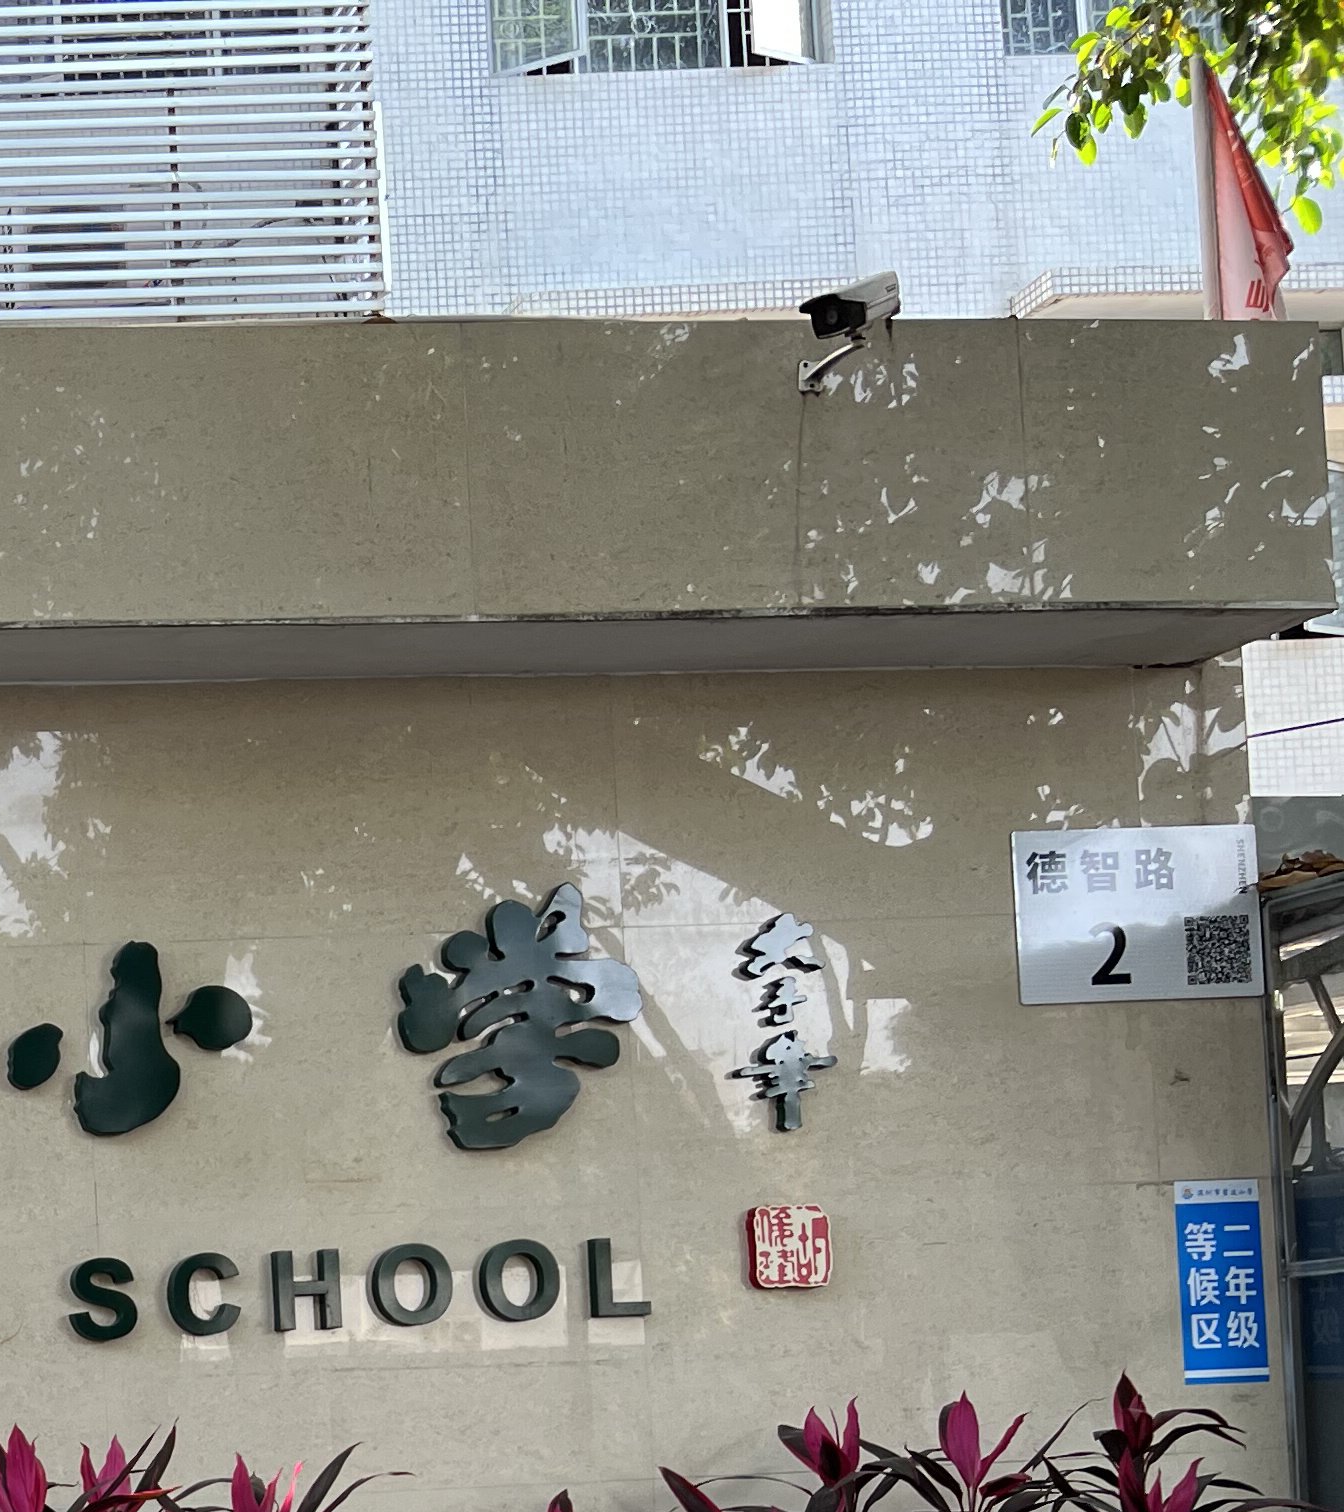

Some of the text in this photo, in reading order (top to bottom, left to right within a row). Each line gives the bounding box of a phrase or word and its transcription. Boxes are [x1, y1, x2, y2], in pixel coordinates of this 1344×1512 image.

[1026, 848, 1175, 894] 德智路
[1236, 838, 1248, 894] SHENZHEN
[1089, 922, 1132, 986] 2
[68, 1237, 652, 1342] SCHOOL
[1184, 1222, 1223, 1350] 等候区
[1223, 1224, 1260, 1349] 二年级
